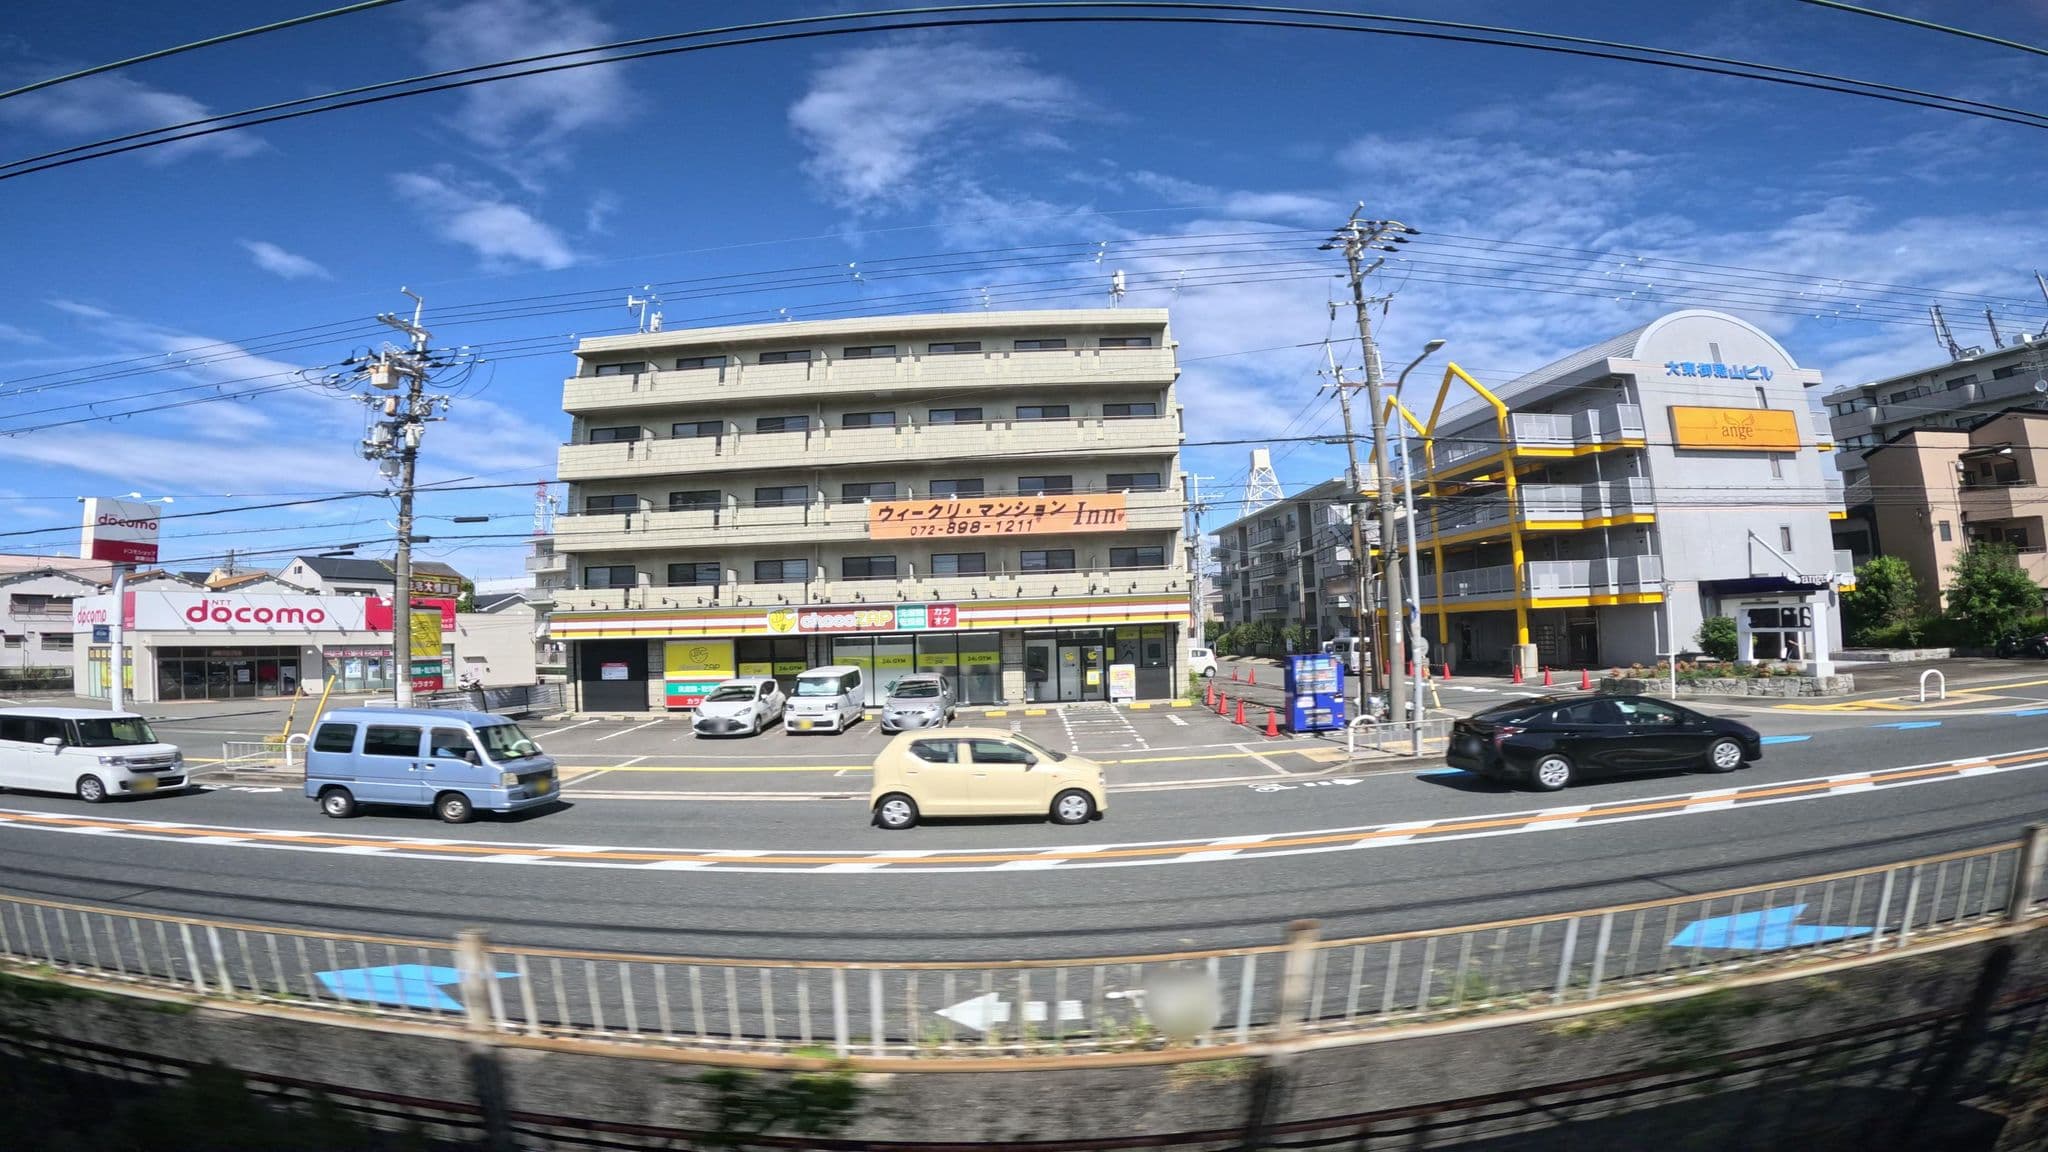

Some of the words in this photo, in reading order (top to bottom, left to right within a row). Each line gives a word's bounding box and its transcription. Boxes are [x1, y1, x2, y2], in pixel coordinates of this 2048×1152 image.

[1721, 425, 1754, 440] ange
[878, 501, 1067, 521] ウィークリ・マンション
[1073, 501, 1117, 526] Inn
[98, 513, 158, 530] docomo
[910, 519, 1034, 537] 072-898-1211
[77, 609, 107, 624] docomo
[186, 600, 326, 624] docomo
[799, 610, 894, 628] chocoZAP
